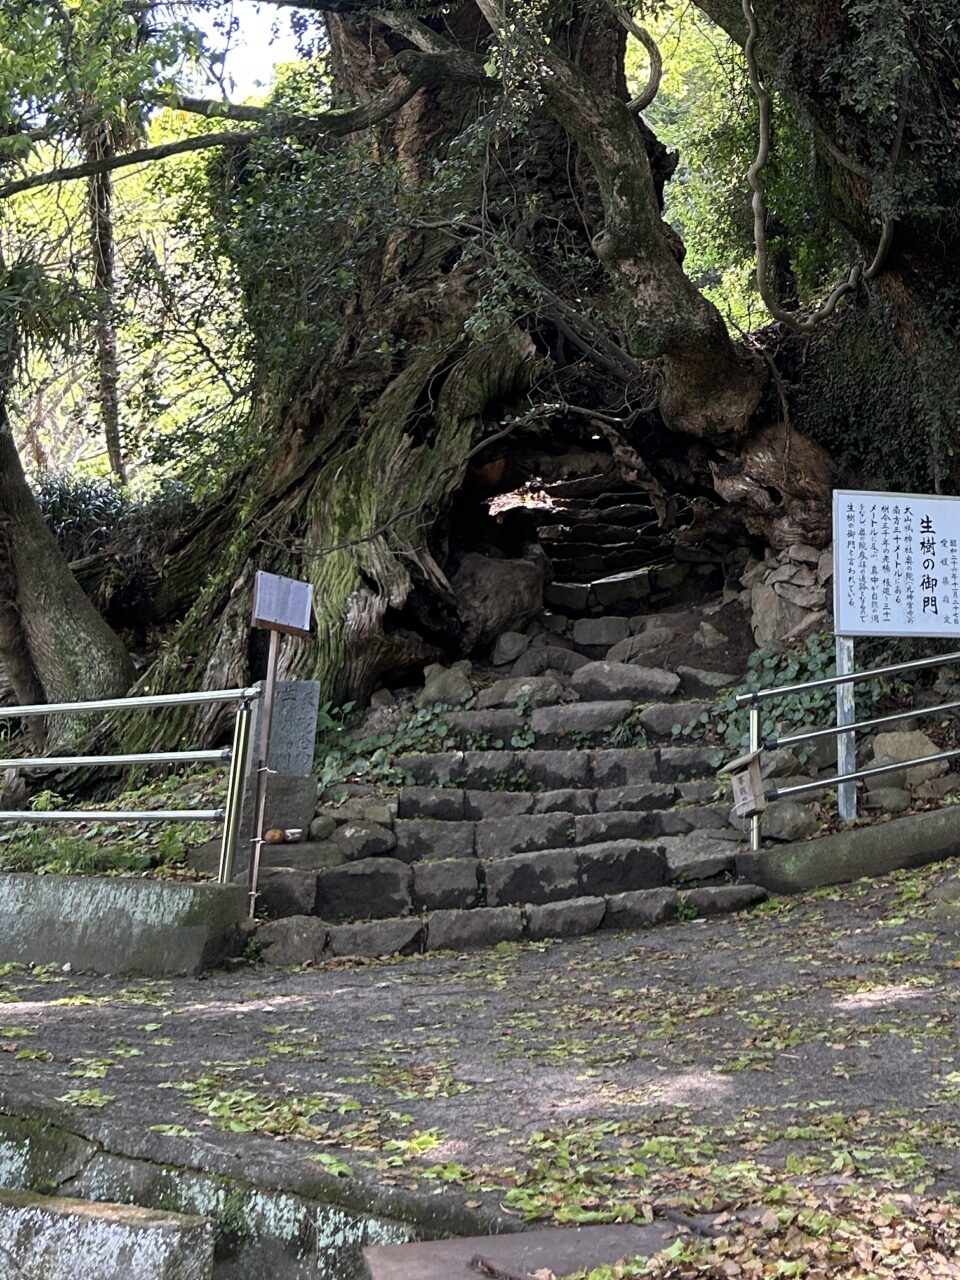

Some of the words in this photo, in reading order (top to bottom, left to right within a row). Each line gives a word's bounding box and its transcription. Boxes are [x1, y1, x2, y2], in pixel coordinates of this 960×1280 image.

[919, 514, 938, 616] 生樹の御門
[940, 539, 952, 625] 愛媛県指定
[296, 691, 315, 773] 天記念物
